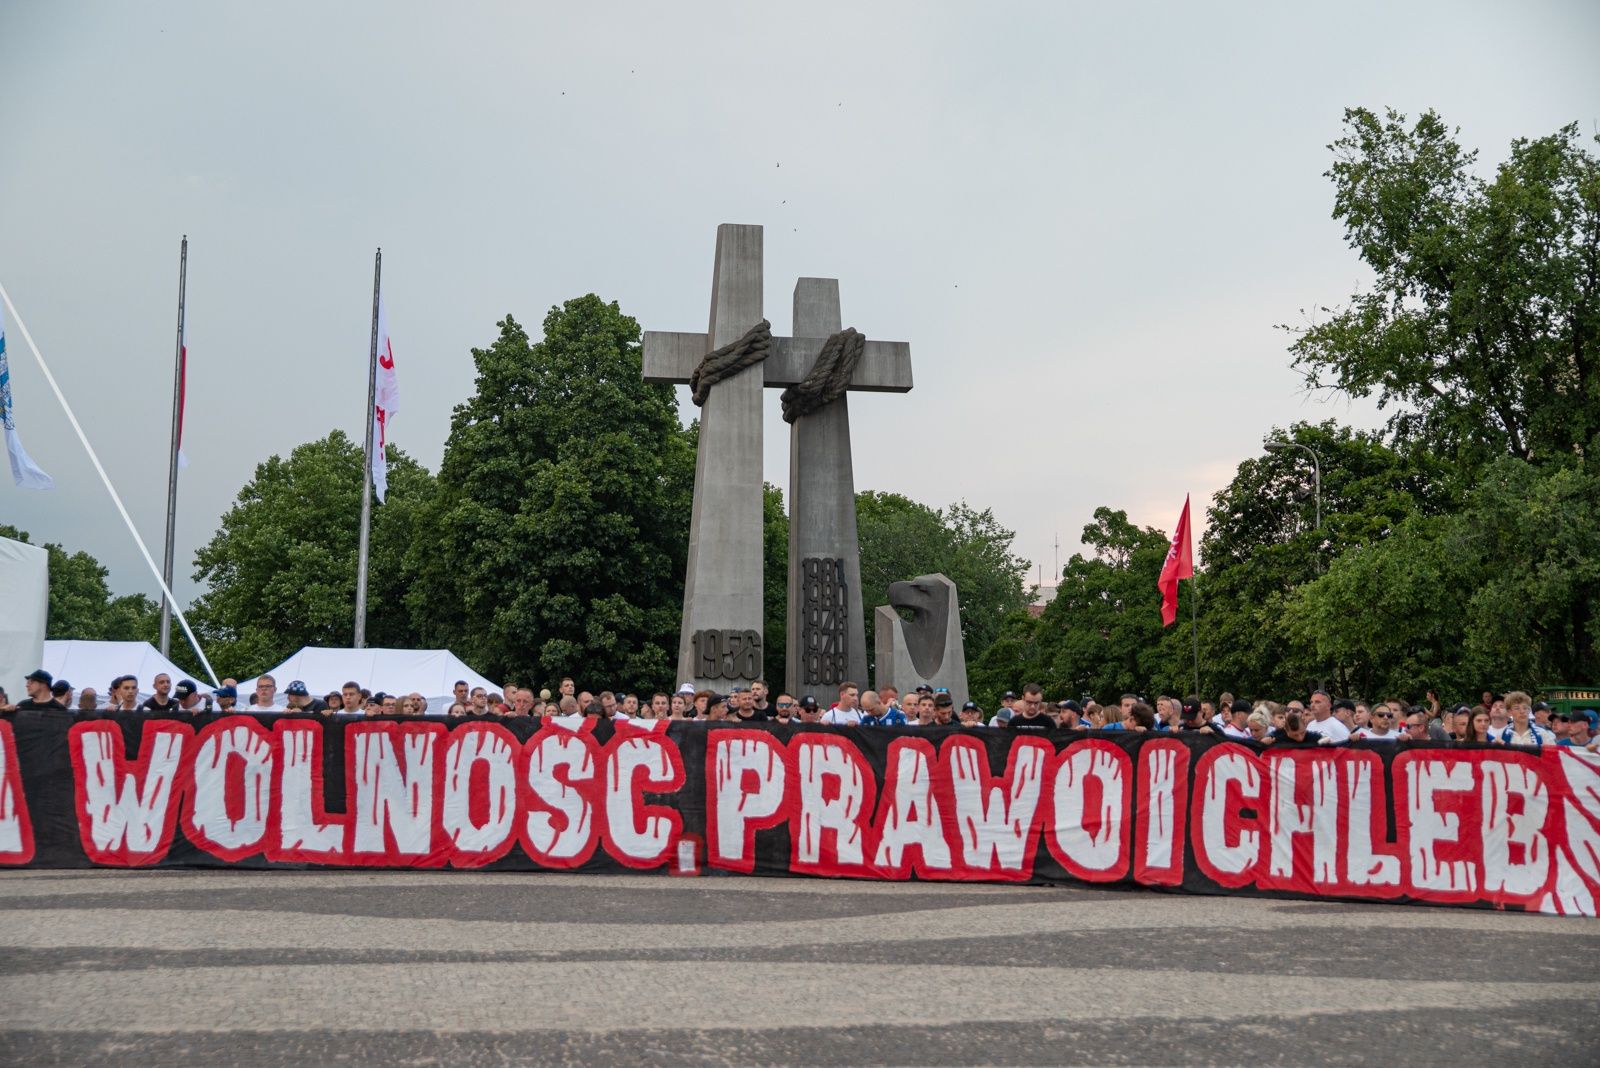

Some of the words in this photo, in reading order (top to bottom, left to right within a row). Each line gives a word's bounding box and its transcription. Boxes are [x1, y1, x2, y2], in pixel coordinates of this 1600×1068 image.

[802, 557, 846, 583] 1981
[802, 581, 849, 607] 1980
[802, 605, 849, 631] 1976
[691, 628, 762, 680] 1956
[802, 630, 849, 656] 1970
[802, 653, 849, 686] 1968
[710, 735, 1128, 874] PRAWO
[1141, 743, 1183, 878] I
[1196, 746, 1553, 898] CHLEB
